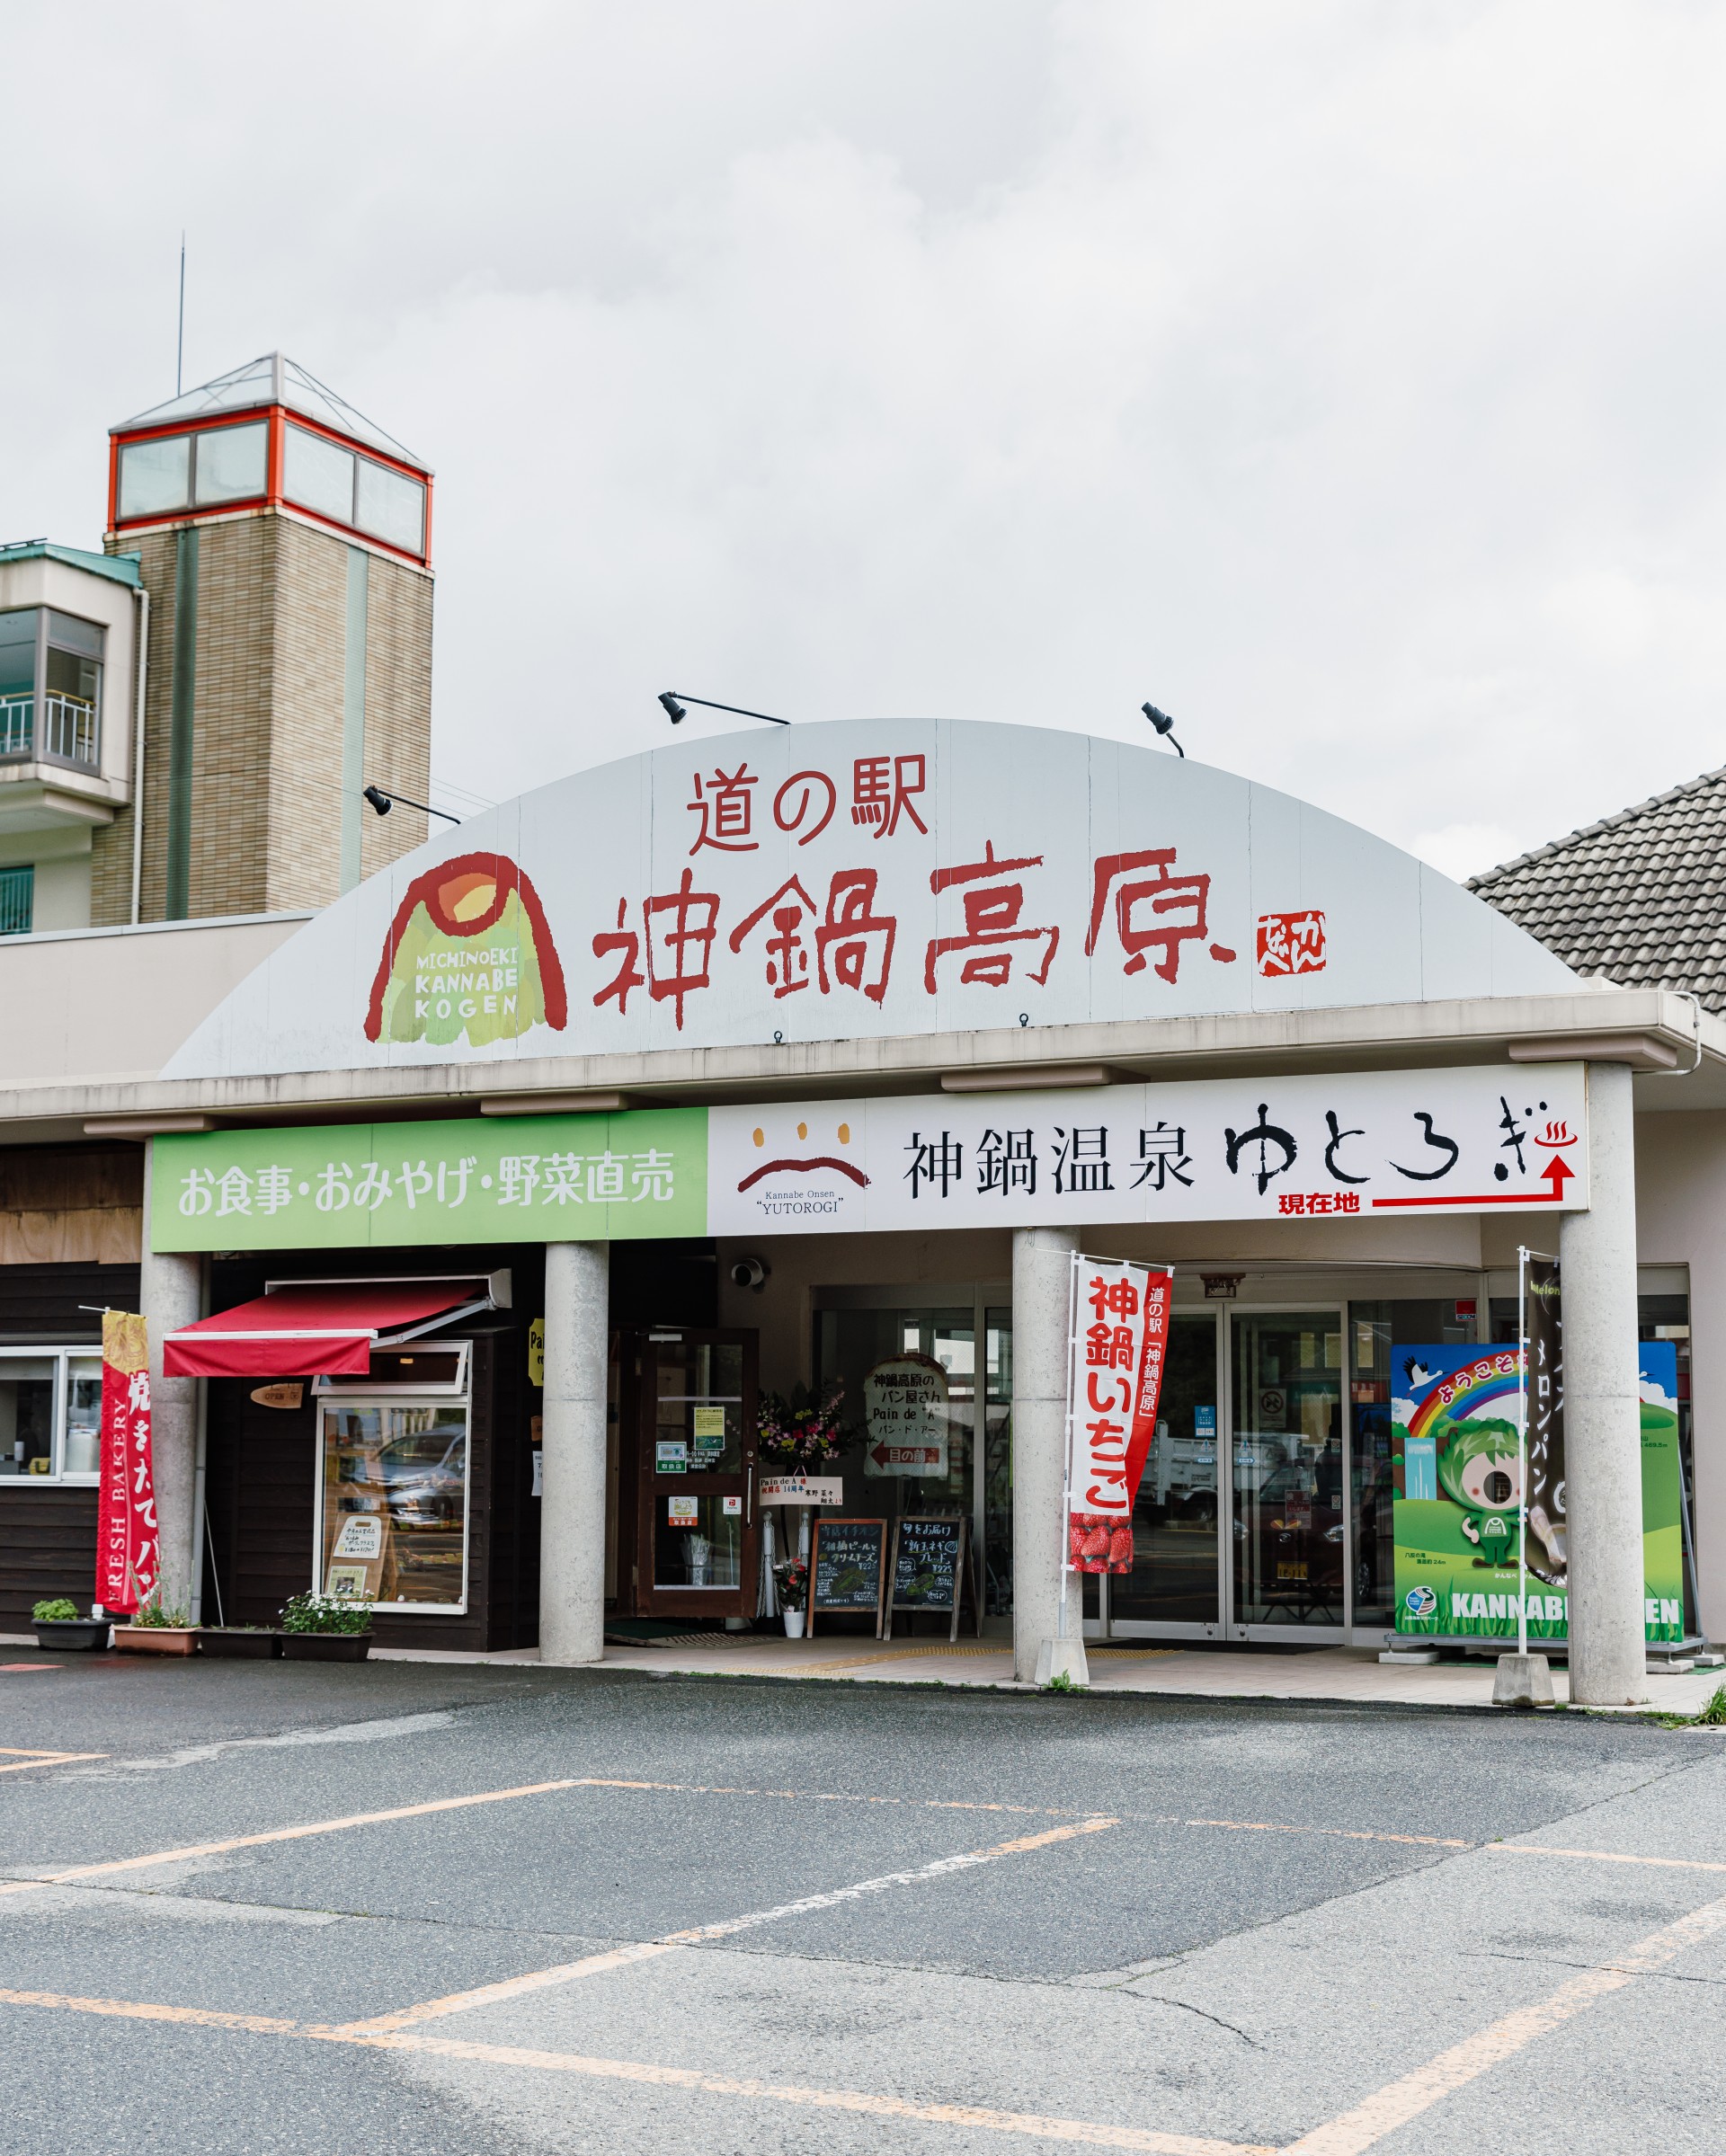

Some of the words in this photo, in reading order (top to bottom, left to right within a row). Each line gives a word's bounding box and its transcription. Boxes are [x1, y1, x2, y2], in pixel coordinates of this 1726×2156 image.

[687, 753, 929, 856] 道の駅
[592, 839, 1237, 1031] 神鍋高原
[416, 947, 518, 970] MICHINOEKI
[415, 968, 518, 994] KANNABE
[415, 994, 517, 1019] KOGEN
[903, 1122, 1195, 1200] 神鍋温泉
[1223, 1096, 1547, 1196] ゆとろぎ
[178, 1148, 675, 1217] お食事・おみやげ・野菜直売
[765, 1191, 804, 1200] Kannabe
[807, 1190, 835, 1199] Onsen
[1278, 1191, 1361, 1215] 現在地
[873, 1373, 935, 1388] 神鍋高原の
[1437, 1352, 1529, 1405] ようこそ
[882, 1389, 942, 1404] パン屋さん
[1085, 1275, 1139, 1509] 神鍋いちご
[873, 1407, 898, 1420] Pain
[903, 1407, 917, 1420] de
[1530, 1338, 1550, 1495] メロンパン
[111, 1398, 129, 1504] BAKERY
[889, 1448, 926, 1463] 目の前
[761, 1478, 778, 1486] Pain
[791, 1477, 796, 1485] A
[761, 1485, 781, 1495] 祝開店
[903, 1522, 951, 1537] 旬をお届け
[108, 1516, 128, 1603] FRESH
[931, 1564, 953, 1574] ¥225
[1452, 1593, 1569, 1621] KANNAB
